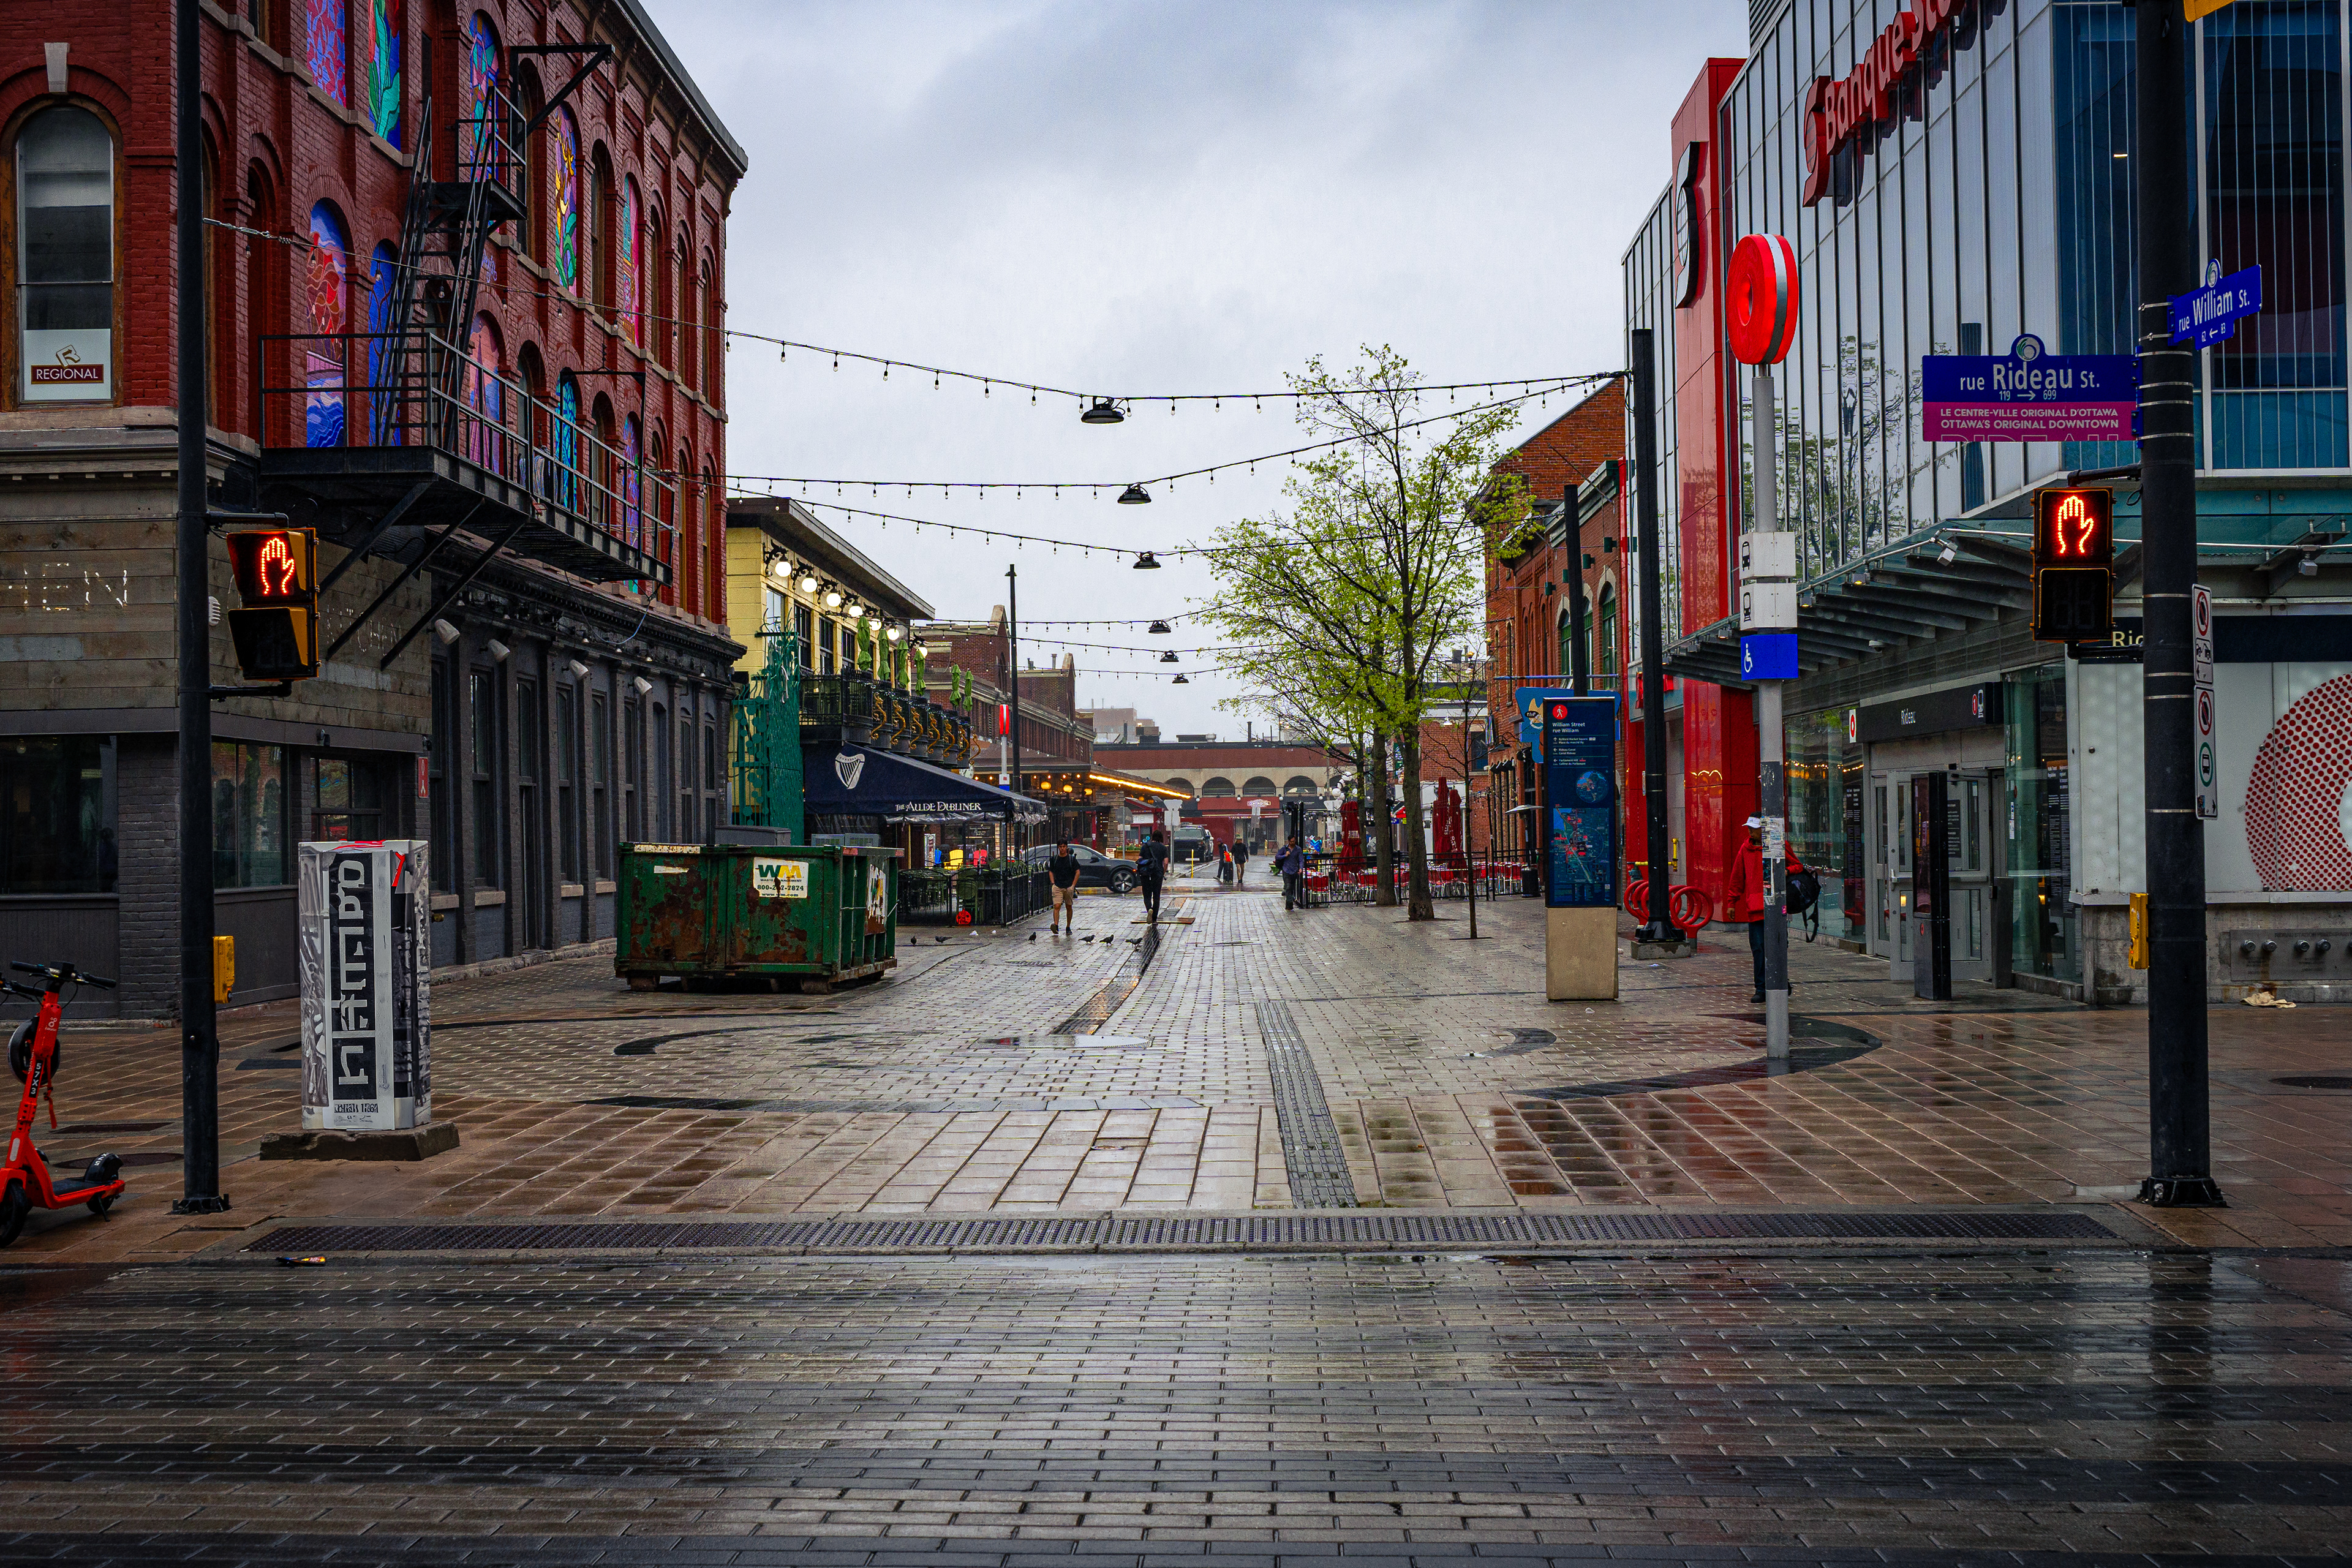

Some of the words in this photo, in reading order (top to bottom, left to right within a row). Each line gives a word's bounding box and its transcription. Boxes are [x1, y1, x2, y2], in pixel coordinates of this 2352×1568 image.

[1825, 9, 1906, 156] Banque
[2179, 315, 2190, 333] rue
[2193, 289, 2233, 326] William
[2239, 289, 2250, 308] St.
[2201, 331, 2206, 342] 62
[2221, 322, 2226, 334] 83
[36, 368, 99, 379] REGIONAL
[1960, 377, 1985, 390] rue
[1993, 361, 2073, 390] Rideau
[2080, 371, 2100, 388] St.
[1999, 390, 2011, 401] 119
[2043, 389, 2057, 401] 699
[1940, 409, 1951, 417] LE
[1954, 409, 2018, 417] CENTRE-VILLE
[2020, 409, 2067, 417] ORIGINAL
[2070, 408, 2118, 417] D'OTTAWA
[1940, 420, 1991, 429] OTTAWA'S
[1993, 420, 2046, 429] ORIGINAL
[2049, 420, 2119, 428] DOWNTOWN
[1901, 708, 1916, 725] Rideau
[937, 801, 982, 812] DUBLINER
[758, 864, 802, 878] WM
[30, 1063, 42, 1095] 57X3
